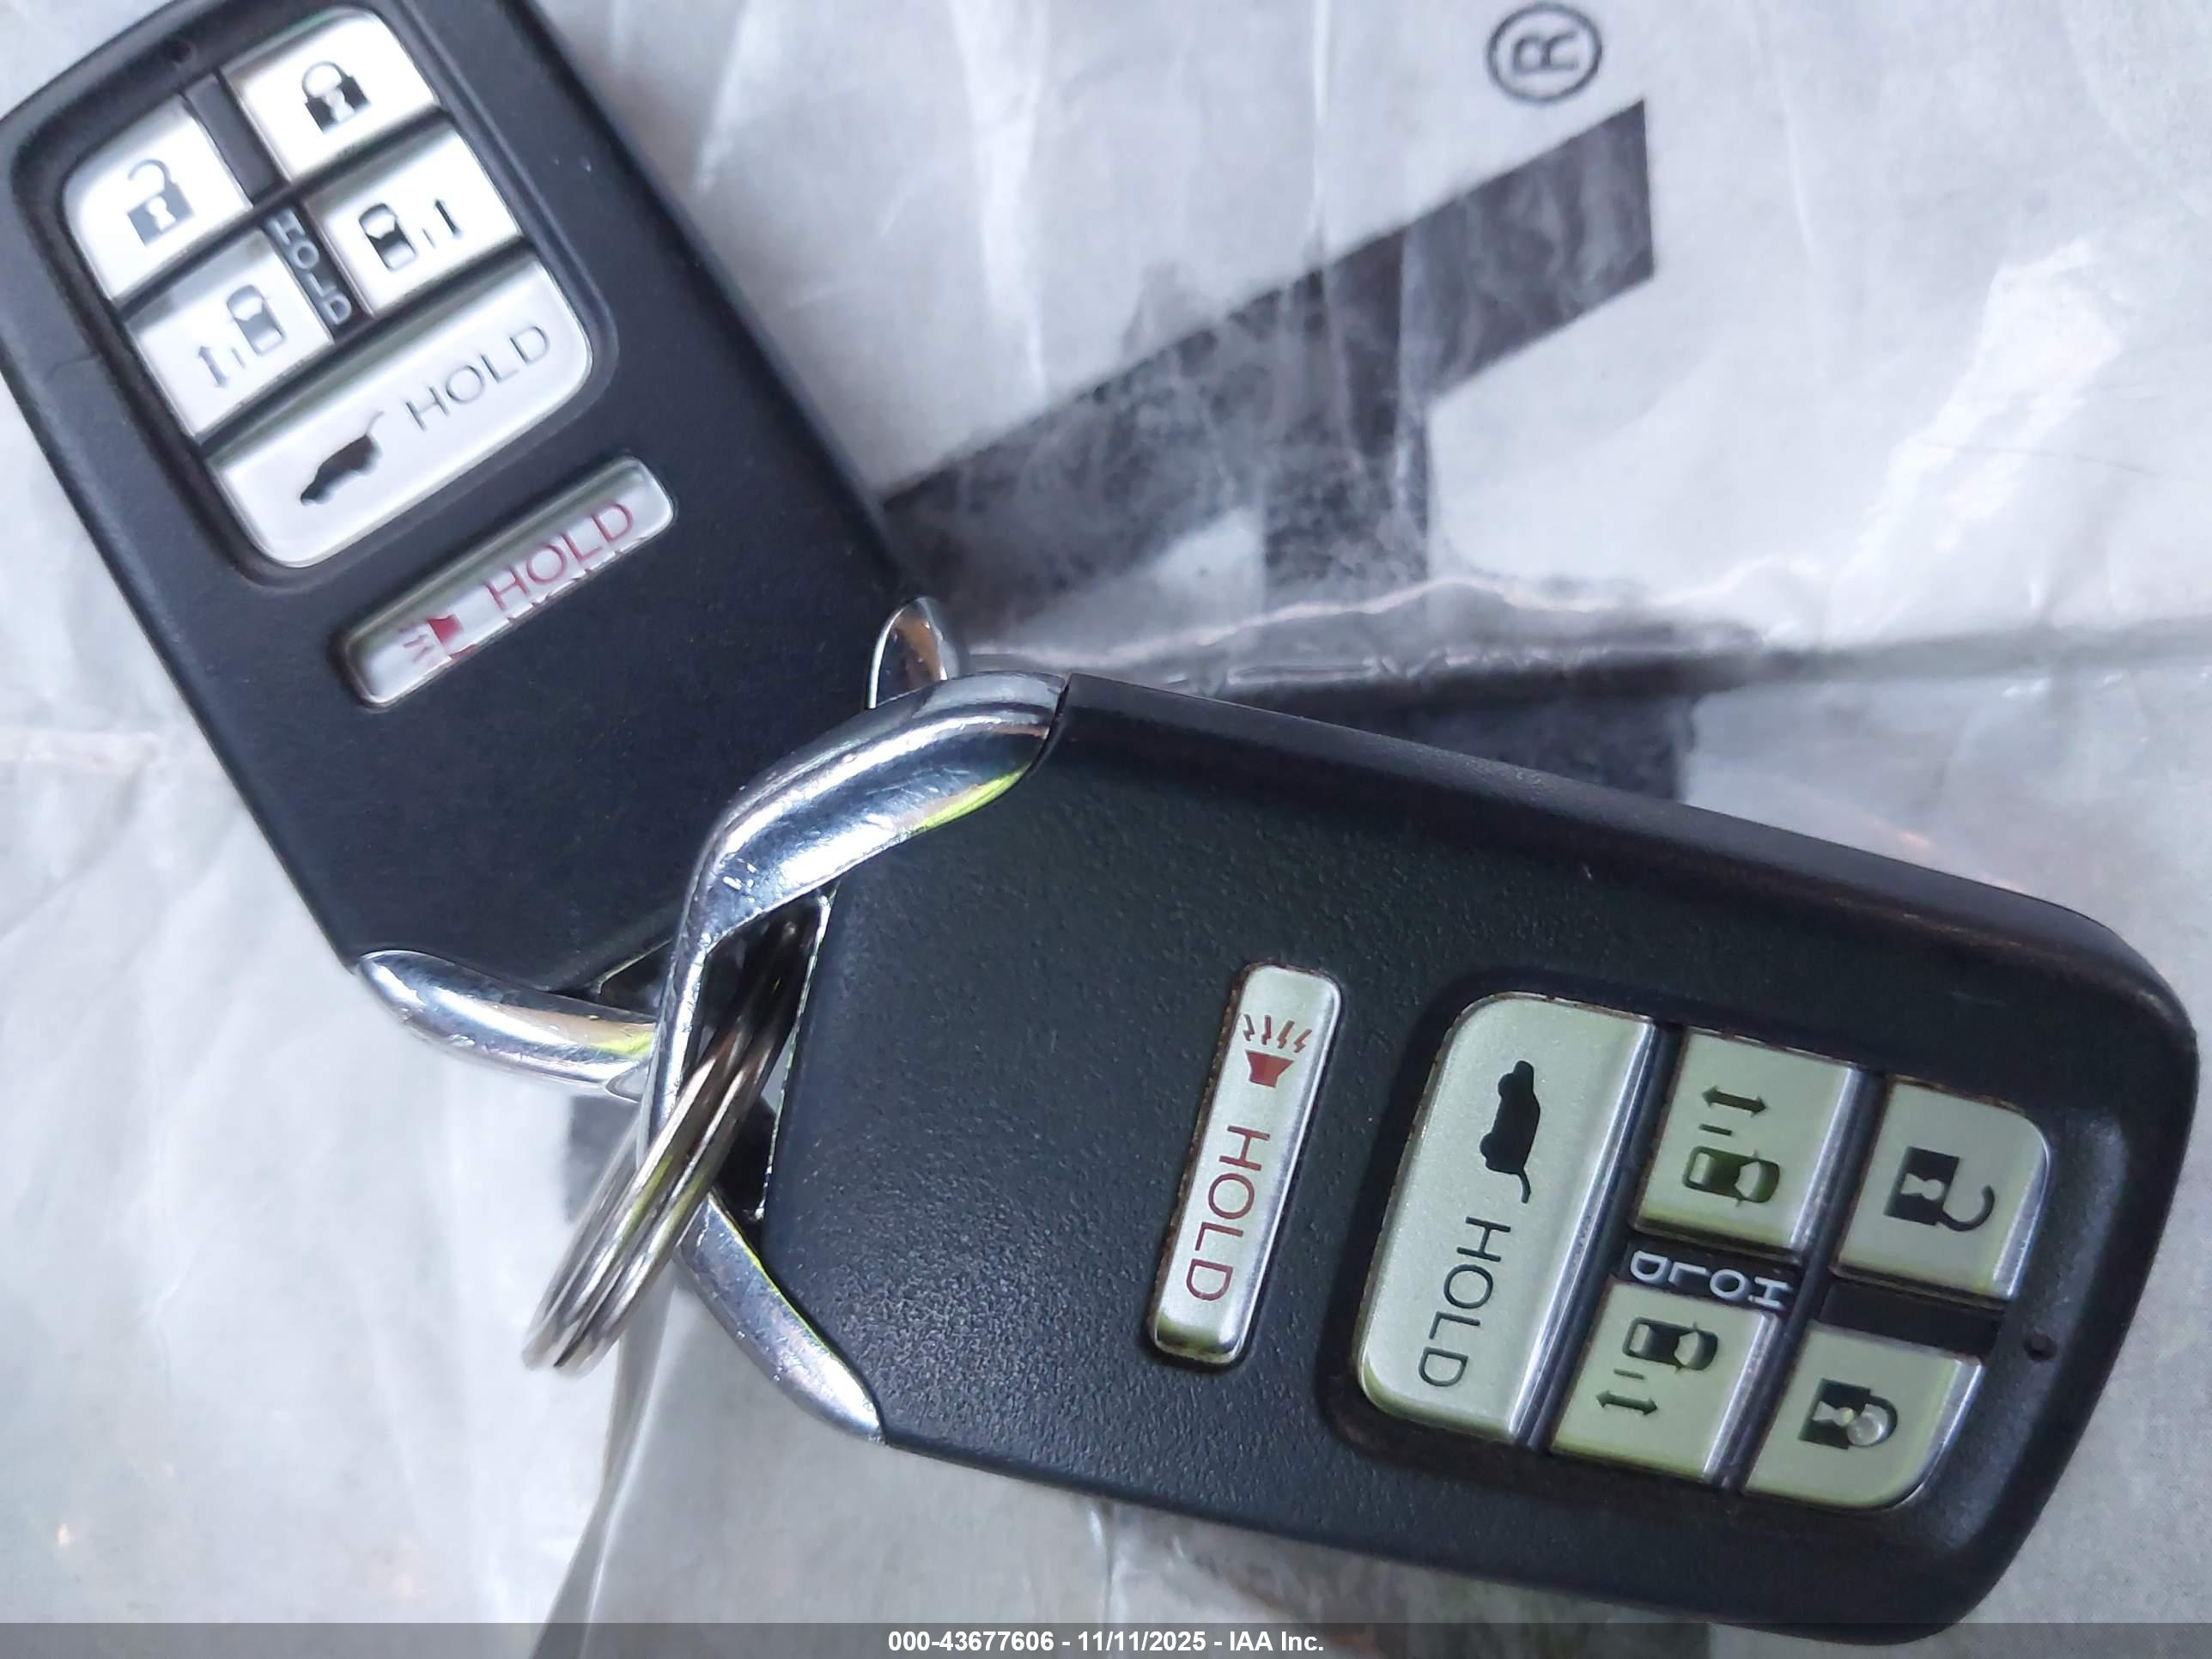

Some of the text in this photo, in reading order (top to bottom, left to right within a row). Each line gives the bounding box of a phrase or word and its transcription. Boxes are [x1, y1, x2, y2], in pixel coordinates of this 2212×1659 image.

[269, 210, 352, 327] HOLD
[405, 324, 550, 431] HOLD
[486, 502, 635, 612] HOLD
[1186, 1125, 1271, 1301] HOLD
[1419, 1216, 1511, 1388] HOLD
[1631, 1249, 1792, 1310] HOLD
